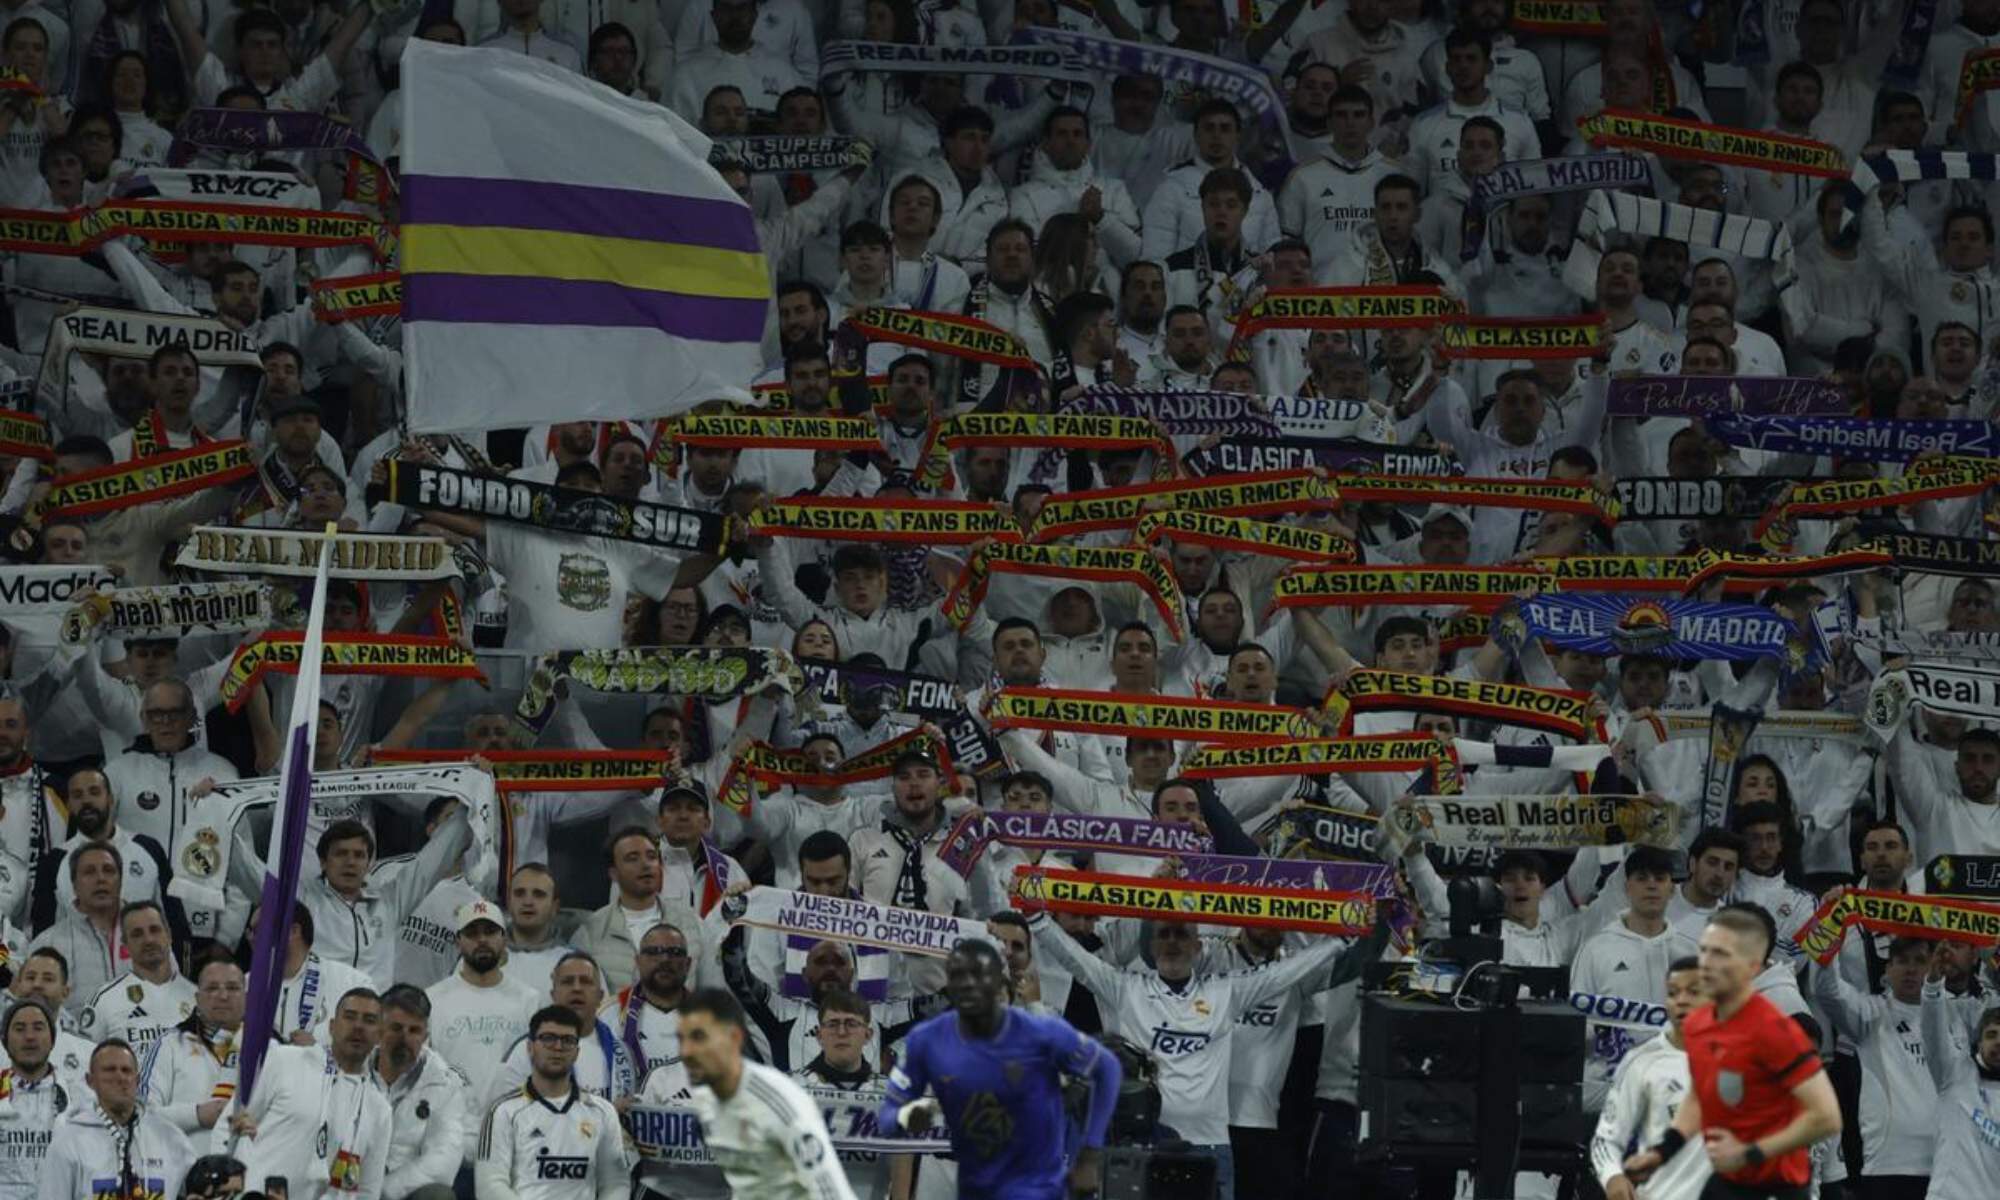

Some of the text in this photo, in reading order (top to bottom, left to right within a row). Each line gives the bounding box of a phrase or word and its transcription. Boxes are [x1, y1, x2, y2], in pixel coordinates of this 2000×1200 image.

[857, 44, 1057, 67] REAL MADRID
[1723, 138, 1770, 157] FANS
[1549, 157, 1645, 183] MADRID
[189, 176, 295, 200] RMCF
[243, 217, 298, 234] FANS
[305, 220, 367, 238] RMCF
[1358, 297, 1416, 316] FANS
[66, 316, 136, 345] REAL
[949, 327, 1006, 354] FANS
[1136, 397, 1241, 421] MADRID
[781, 419, 830, 437] FANS
[1054, 416, 1112, 436] FANS
[161, 453, 217, 486] FANS
[1176, 489, 1233, 510] FANS
[1241, 481, 1302, 504] RMCF
[419, 470, 700, 547] FONDO SUR
[901, 511, 959, 530] FANS
[199, 532, 442, 569] REAL MADRID
[1265, 527, 1322, 550] FANS
[1897, 537, 1969, 562] REAL
[1077, 549, 1134, 569] FANS
[1420, 574, 1478, 592] FANS
[113, 598, 161, 626] Real
[1530, 602, 1787, 644] REAL MADRID
[358, 646, 408, 664] FANS
[415, 646, 468, 665] RMCF
[1910, 672, 1977, 704] Real
[1432, 679, 1467, 698] DE
[1479, 684, 1586, 722] EUROPA
[1153, 707, 1211, 730] FANS
[1219, 713, 1284, 734] RMCF
[1326, 741, 1382, 760] FANS
[524, 760, 652, 777] FANS RMCF
[311, 784, 371, 794] HAMPIONS
[1445, 802, 1615, 826] Real Madrid
[793, 894, 959, 934] VUESTRA ENVIDIA
[1200, 896, 1262, 916] FANS
[1269, 900, 1336, 922] RMCF
[779, 911, 868, 939] NUESTRO
[1946, 911, 1999, 934] FANS
